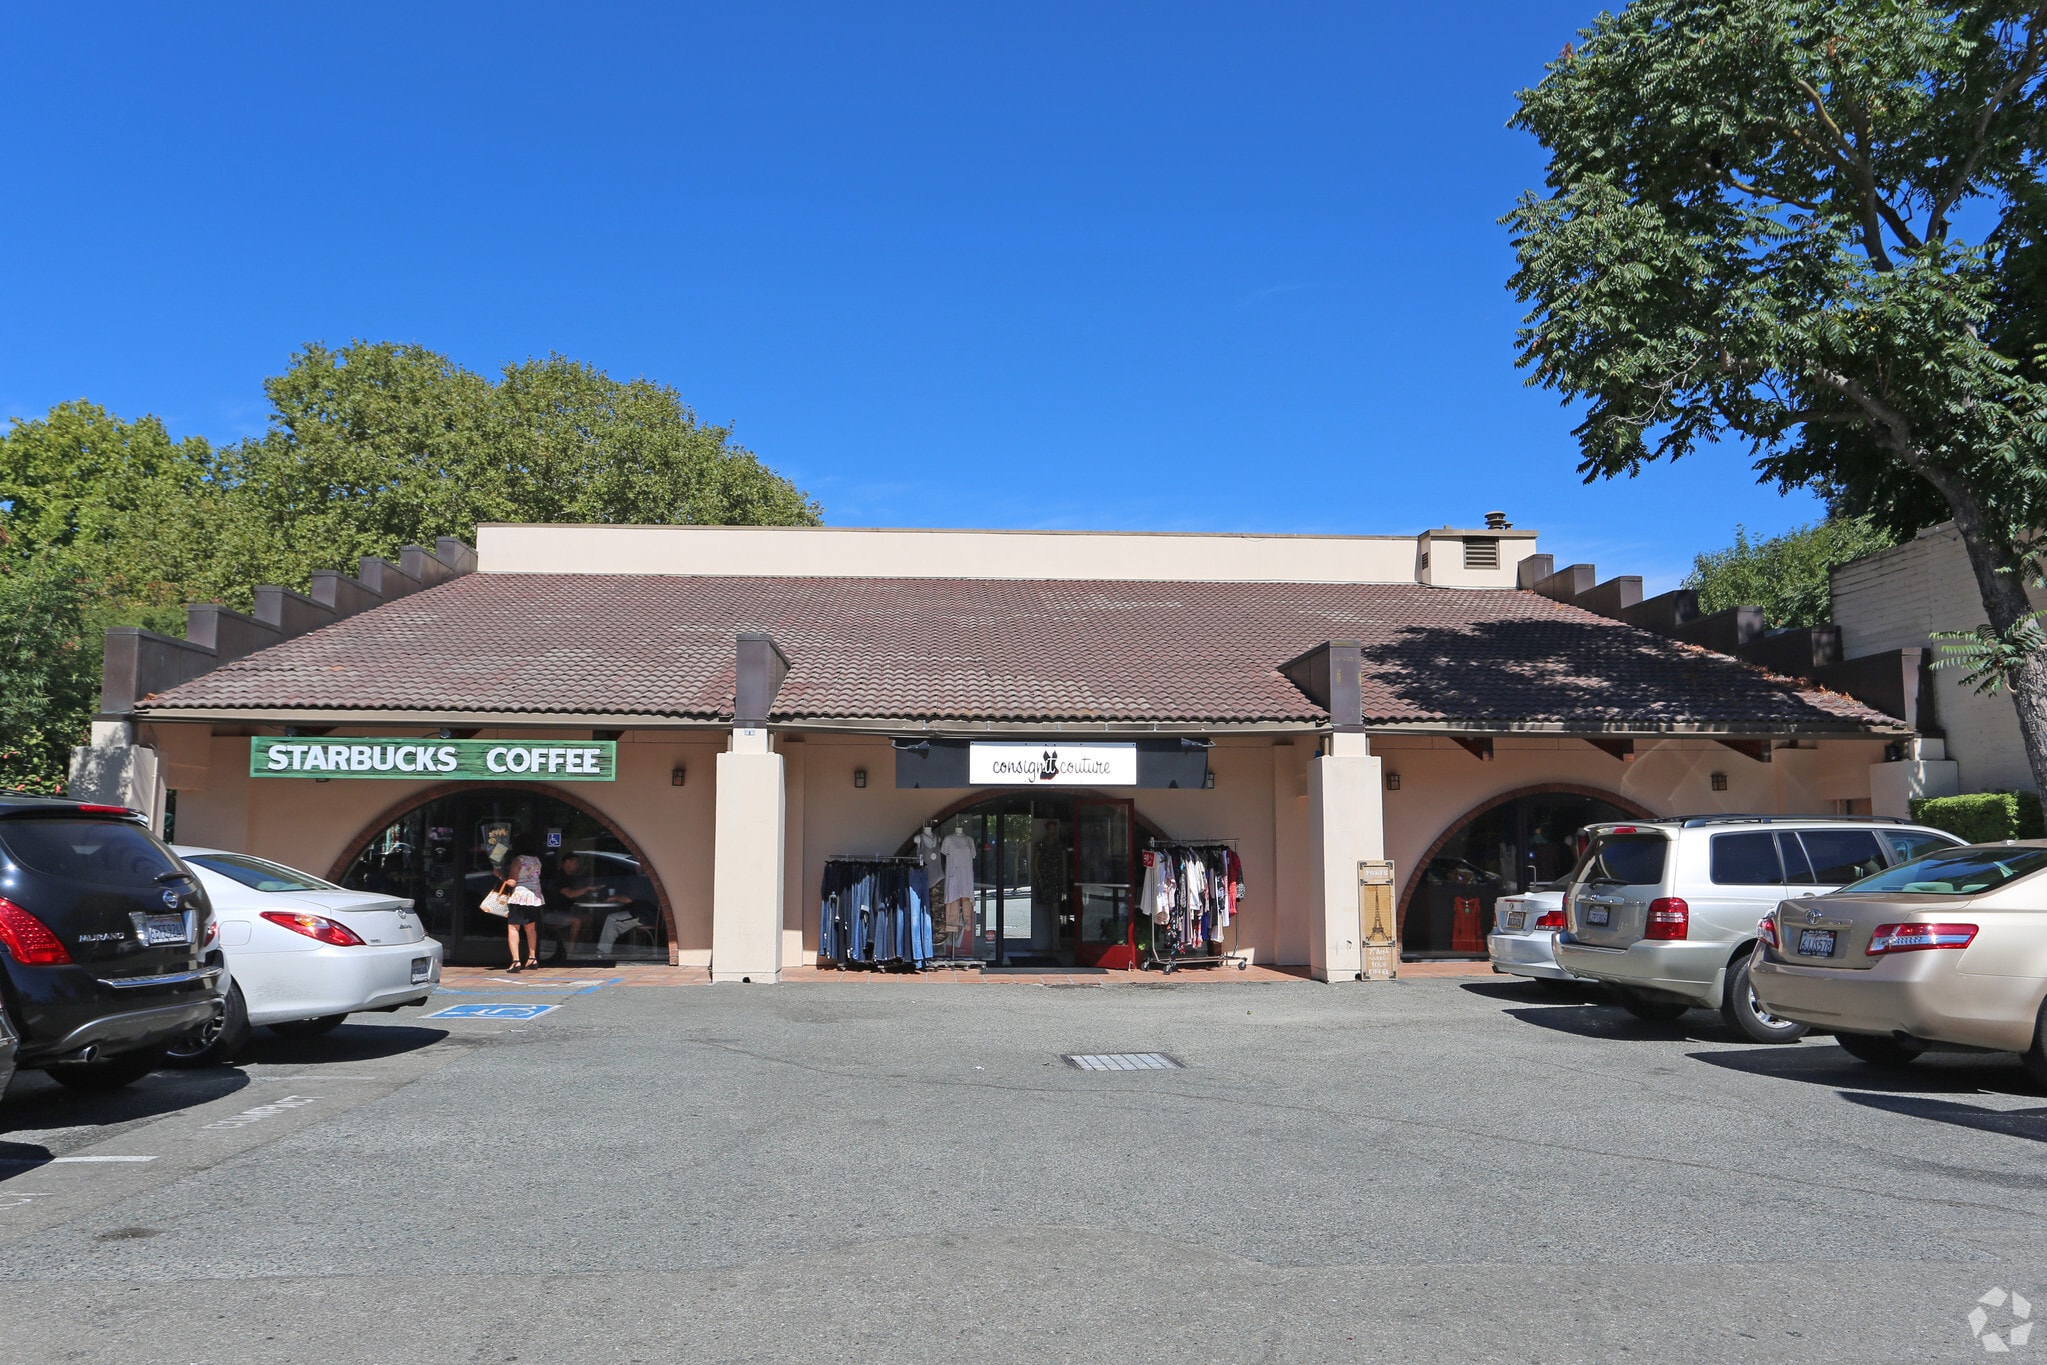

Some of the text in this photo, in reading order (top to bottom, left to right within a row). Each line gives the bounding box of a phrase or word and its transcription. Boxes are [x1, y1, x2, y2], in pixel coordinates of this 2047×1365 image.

[267, 744, 601, 774] STARBUCKS COFFEE
[1060, 758, 1112, 775] couture
[79, 932, 125, 943] MURANO
